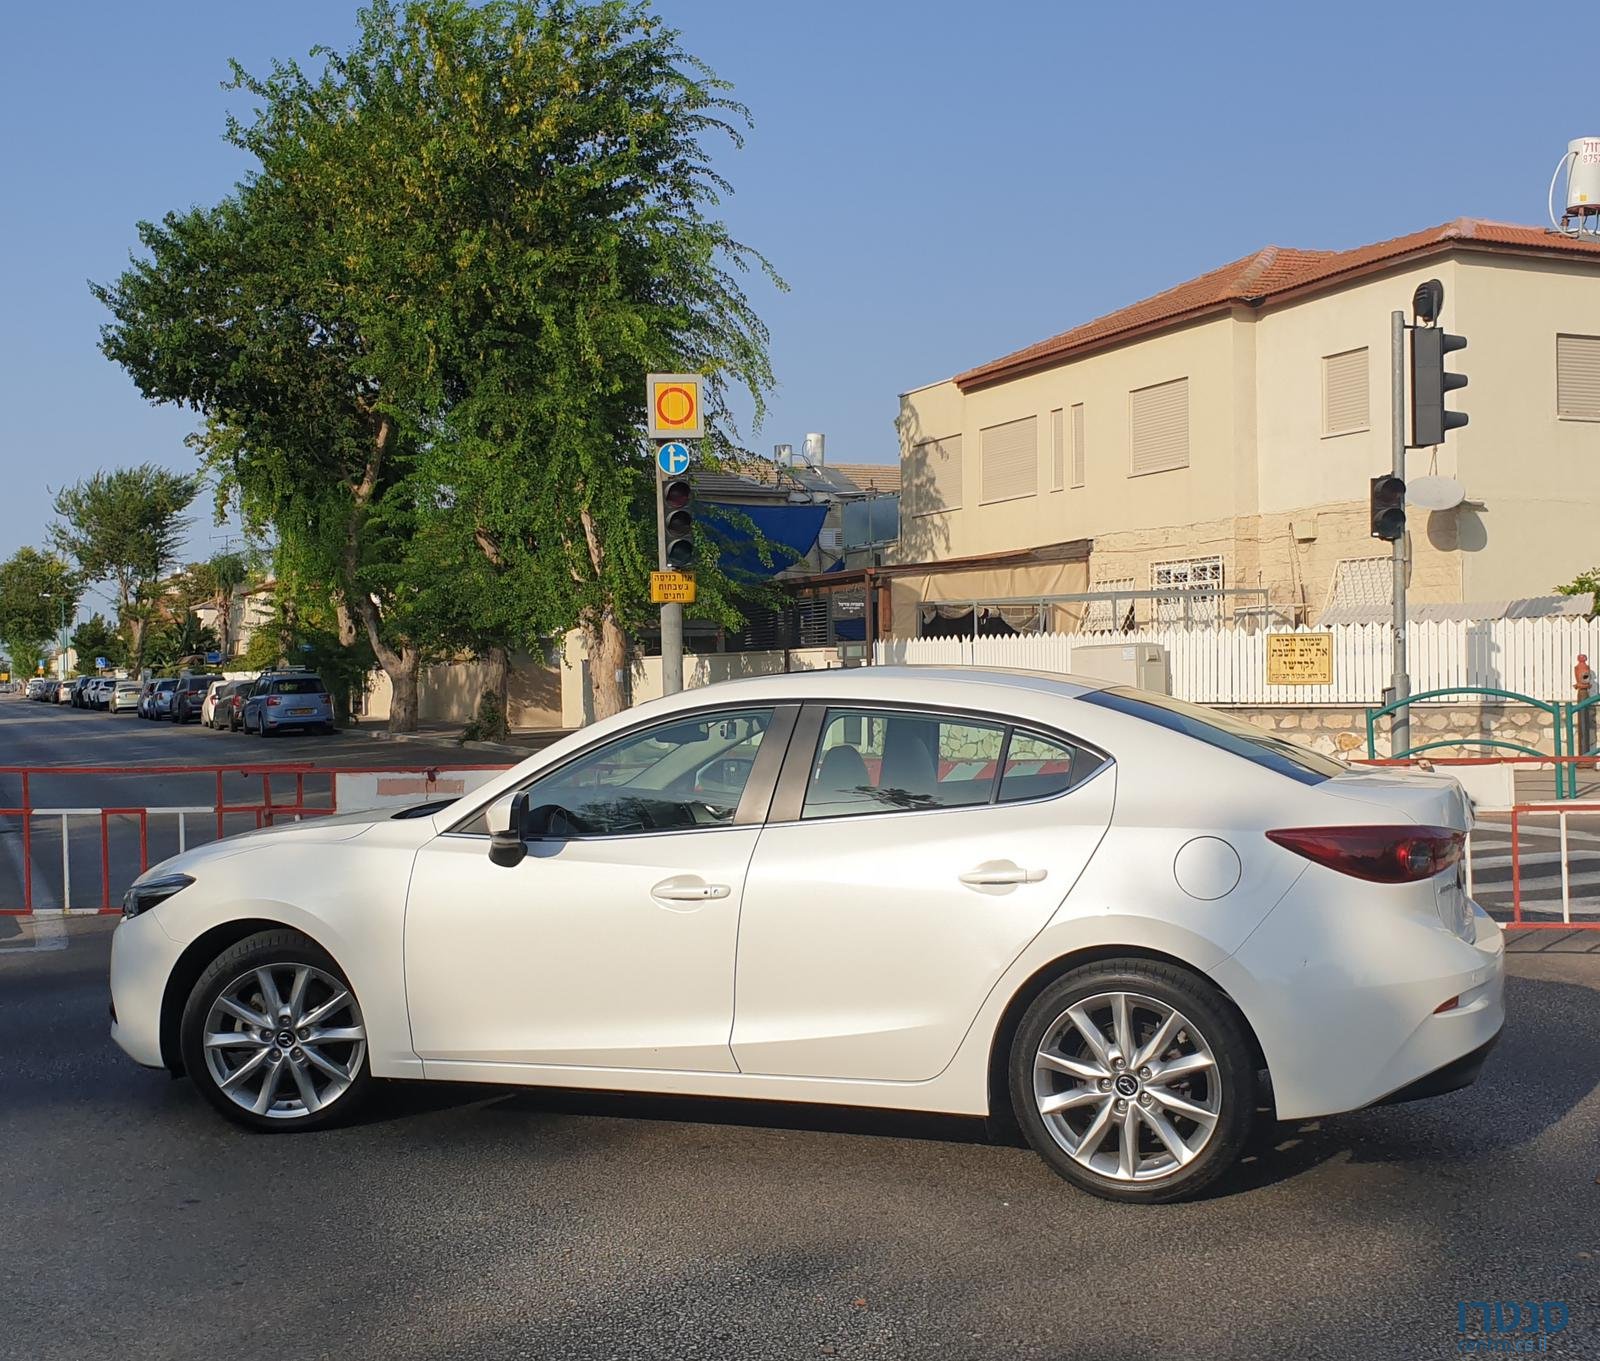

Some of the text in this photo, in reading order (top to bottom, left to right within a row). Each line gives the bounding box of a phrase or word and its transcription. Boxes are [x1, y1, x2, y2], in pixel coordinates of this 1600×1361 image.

[654, 574, 693, 582] אין כניסה
[658, 583, 689, 591] בשבתות
[663, 592, 685, 600] וחגים
[1299, 637, 1322, 647] שמור
[1271, 648, 1328, 657] את יום השבת
[1283, 658, 1315, 671] לקדשו
